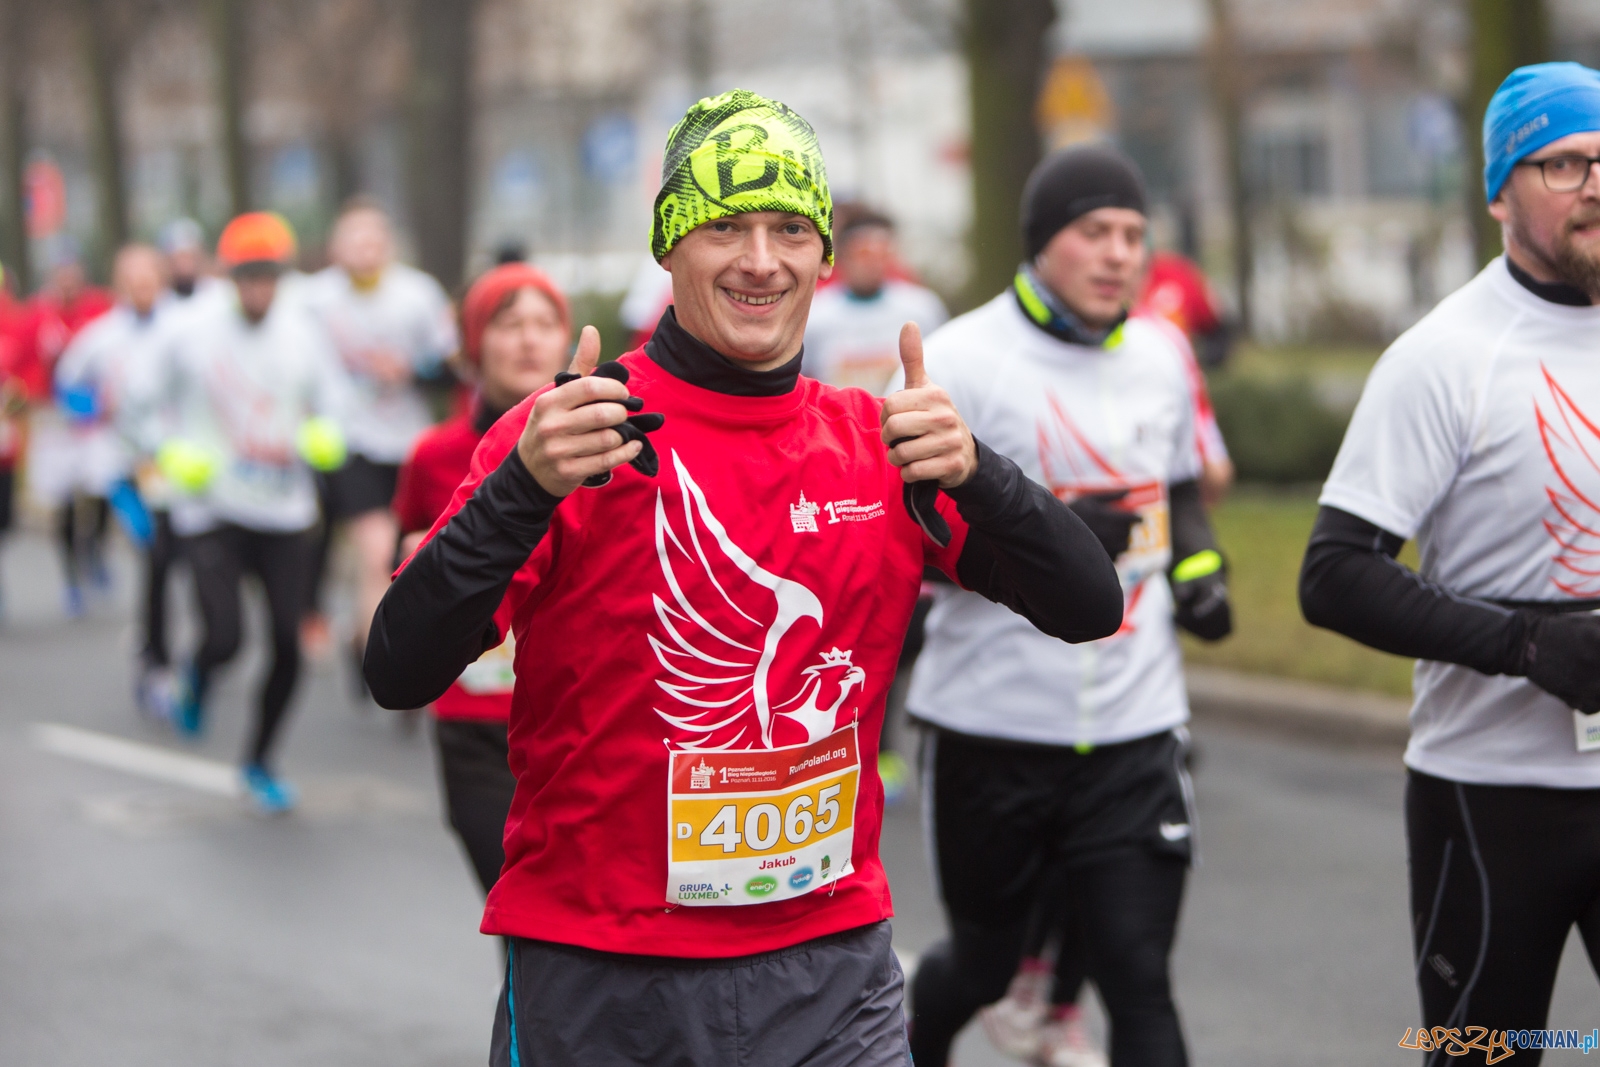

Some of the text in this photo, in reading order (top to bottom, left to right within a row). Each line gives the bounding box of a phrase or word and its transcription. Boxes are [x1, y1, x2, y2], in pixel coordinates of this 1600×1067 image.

[824, 501, 840, 524] 1
[789, 747, 847, 776] RunPoland.org
[719, 766, 729, 783] 1
[676, 782, 842, 853] D 4065
[758, 856, 796, 870] Jakub
[679, 883, 714, 892] GRUPA
[750, 882, 775, 892] energy
[678, 891, 719, 900] LUXMED
